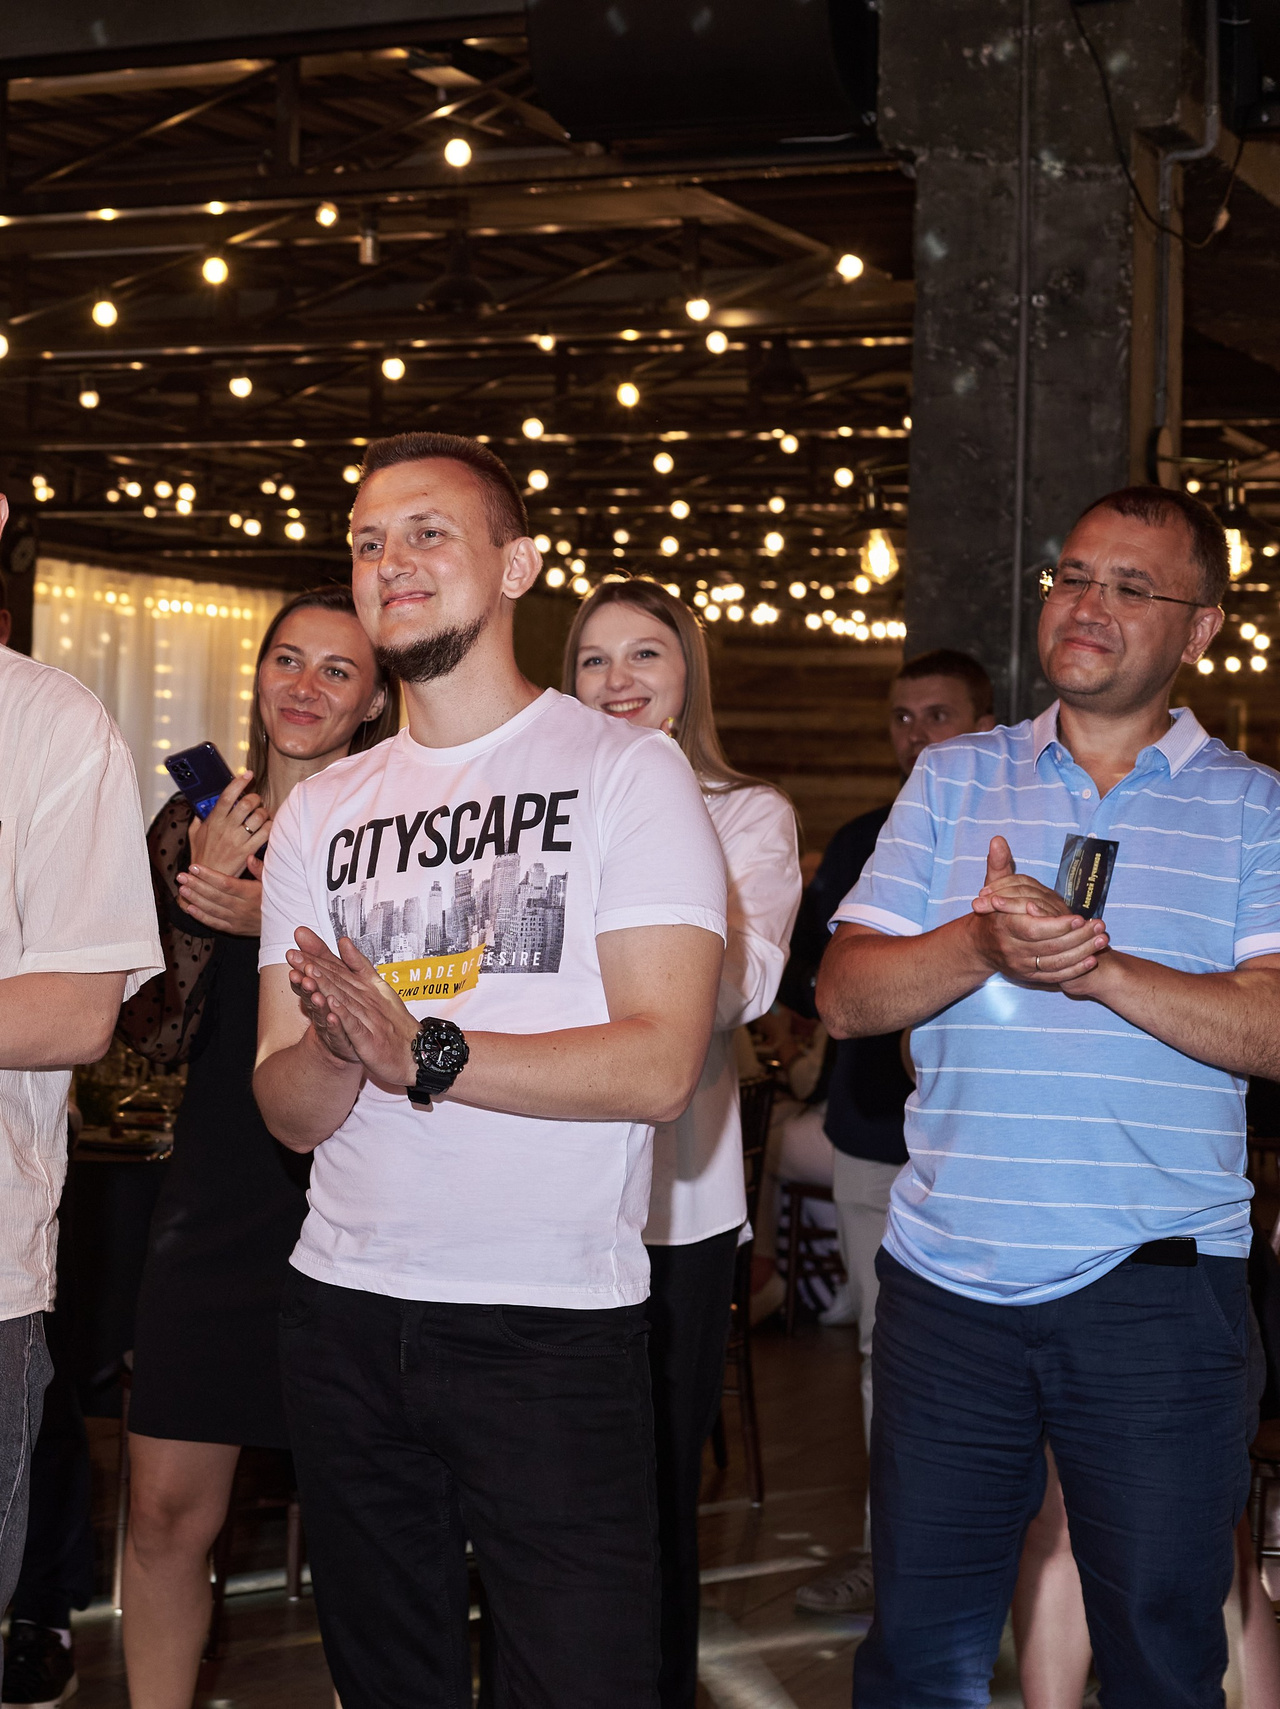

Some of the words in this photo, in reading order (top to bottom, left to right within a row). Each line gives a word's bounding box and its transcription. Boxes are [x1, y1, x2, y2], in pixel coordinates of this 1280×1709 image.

[326, 789, 579, 892] CITYSCAPE
[380, 970, 400, 983] TS
[409, 963, 454, 982] MADE
[461, 957, 475, 975] OF
[477, 951, 542, 967] DESIRE
[398, 986, 420, 998] FIND
[423, 983, 449, 995] YOUR
